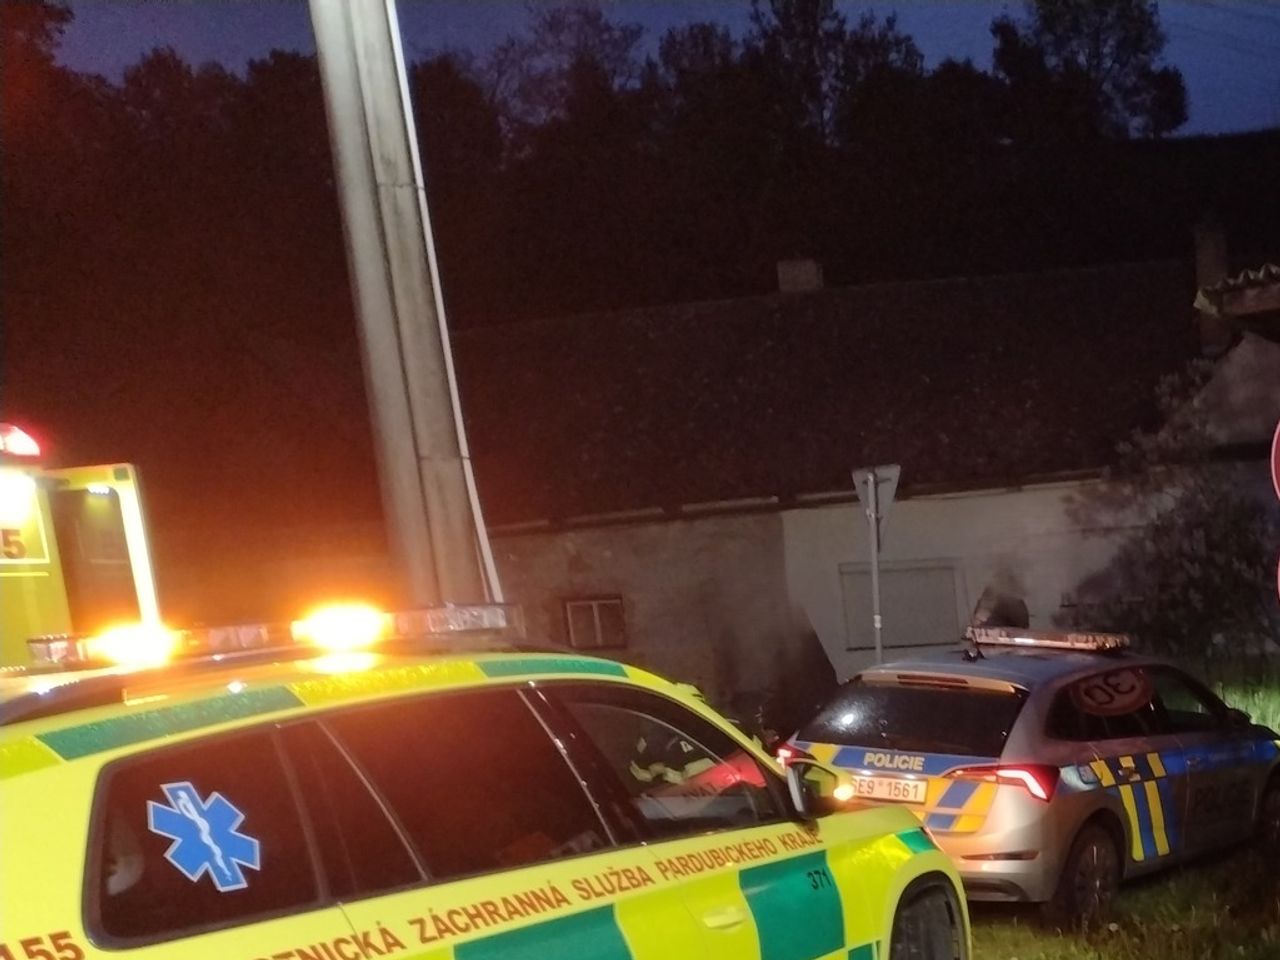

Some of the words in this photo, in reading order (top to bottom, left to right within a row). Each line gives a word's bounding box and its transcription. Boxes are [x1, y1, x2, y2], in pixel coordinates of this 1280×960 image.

[863, 752, 925, 772] POLICIE
[887, 781, 919, 799] 1561
[408, 880, 573, 944] ZÁCHRANNÁ
[570, 866, 656, 901] SLUŽBA
[654, 834, 778, 880] PARDUBICKÉHO
[778, 830, 823, 851] KRAJE
[807, 868, 832, 890] 371
